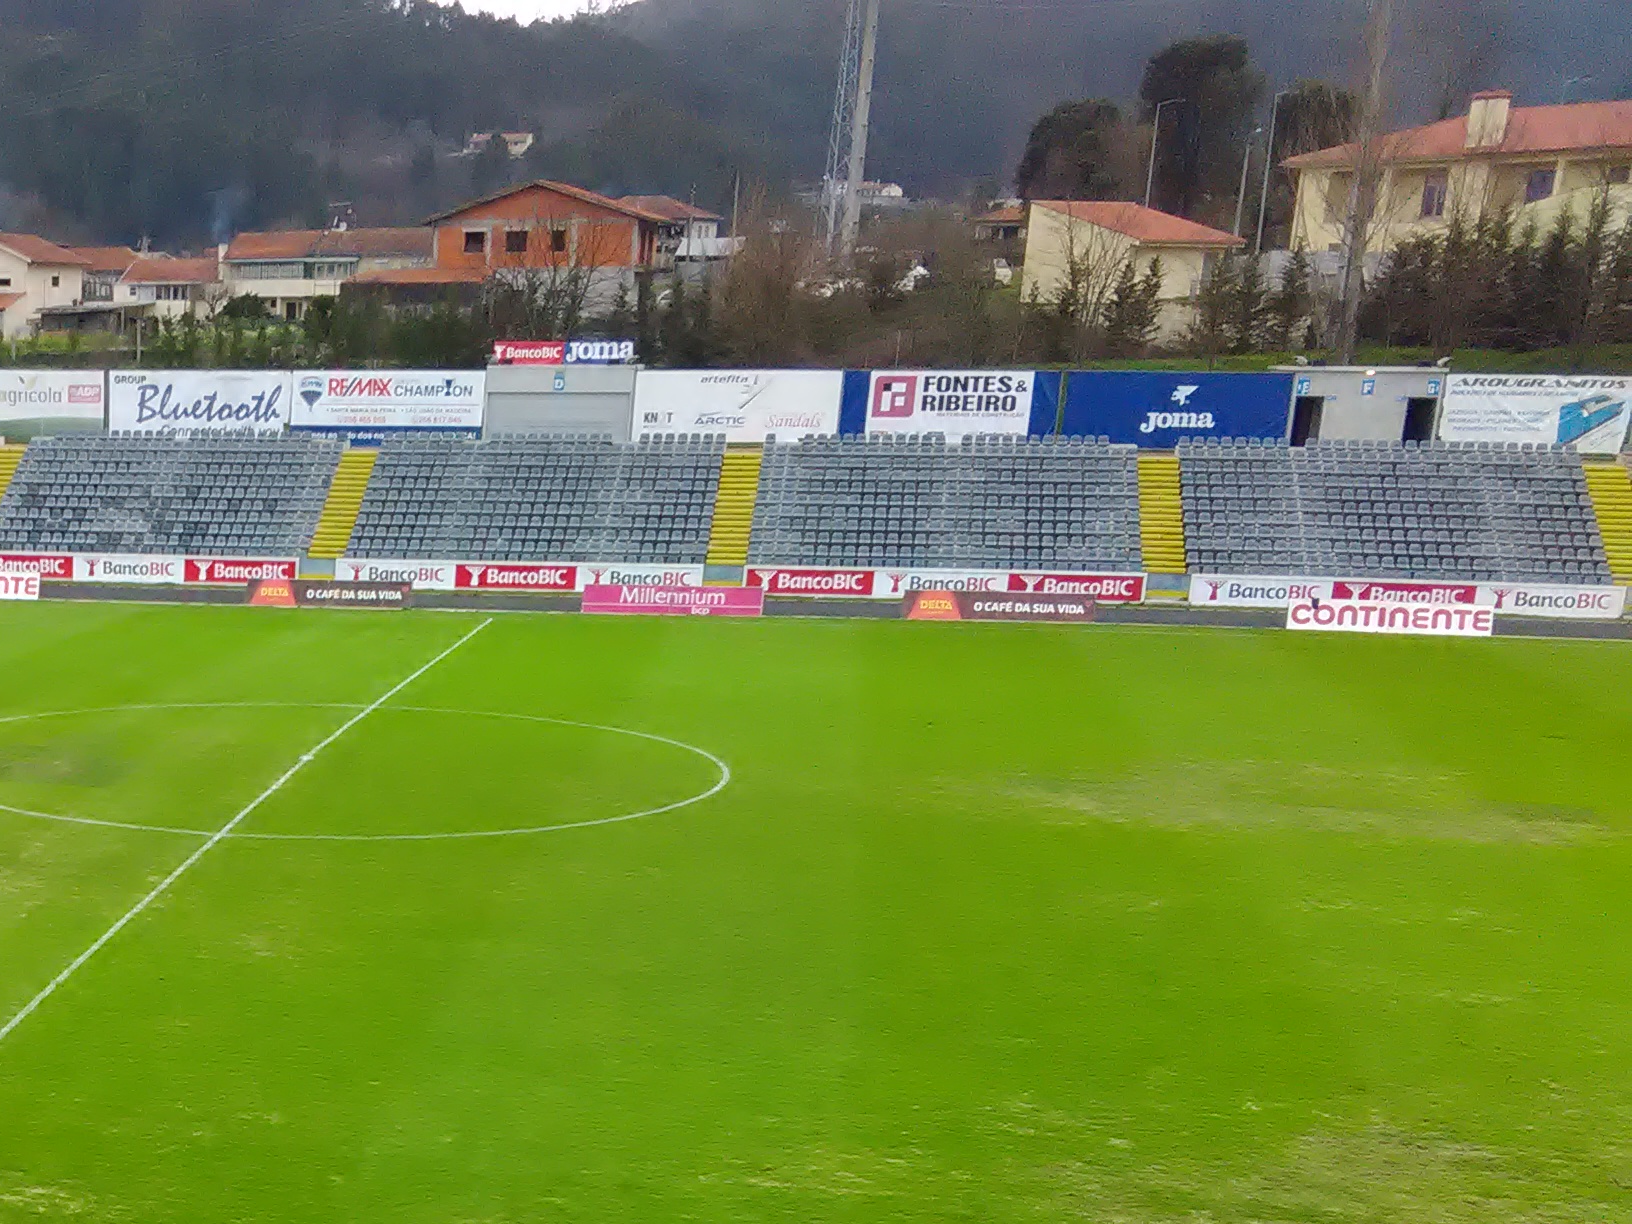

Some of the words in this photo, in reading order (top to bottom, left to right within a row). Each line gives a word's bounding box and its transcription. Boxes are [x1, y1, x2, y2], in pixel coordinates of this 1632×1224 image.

[506, 346, 562, 359] BancoBIC
[114, 375, 147, 384] GROUP
[328, 377, 392, 397] RE/MAX
[923, 376, 1013, 393] FONTES
[1015, 380, 1028, 393] &
[1362, 381, 1372, 394] F
[1452, 377, 1628, 389] AROUGRANITOS
[136, 383, 283, 423] Bluetooth
[921, 395, 1017, 412] RIBEIRO
[694, 416, 746, 425] ARCTIC
[102, 560, 175, 577] BancoBIC
[214, 563, 289, 580] BancoBIC
[368, 566, 445, 583] BancoBIC
[486, 568, 567, 586] BancoBIC
[609, 570, 691, 586] BancoBIC
[777, 573, 865, 591] BancoBIC
[909, 575, 997, 591] BancoBIC
[1043, 577, 1135, 596] BancoBIC
[306, 590, 314, 599] O
[316, 588, 341, 599] CAFÉ
[342, 590, 355, 599] DA
[357, 590, 376, 600] SUA
[378, 590, 402, 600] VIDA
[619, 586, 726, 605] Millennium
[1228, 582, 1321, 600] BancoBIC
[1369, 586, 1466, 604] BancoBIC
[973, 601, 983, 612] O
[984, 600, 1014, 613] CAFÉ
[1014, 602, 1030, 613] DA
[1032, 603, 1056, 614] SUA
[1057, 604, 1085, 615] VIDA
[1514, 591, 1611, 610] BancoBIC
[1291, 602, 1492, 632] CONTINENTE
